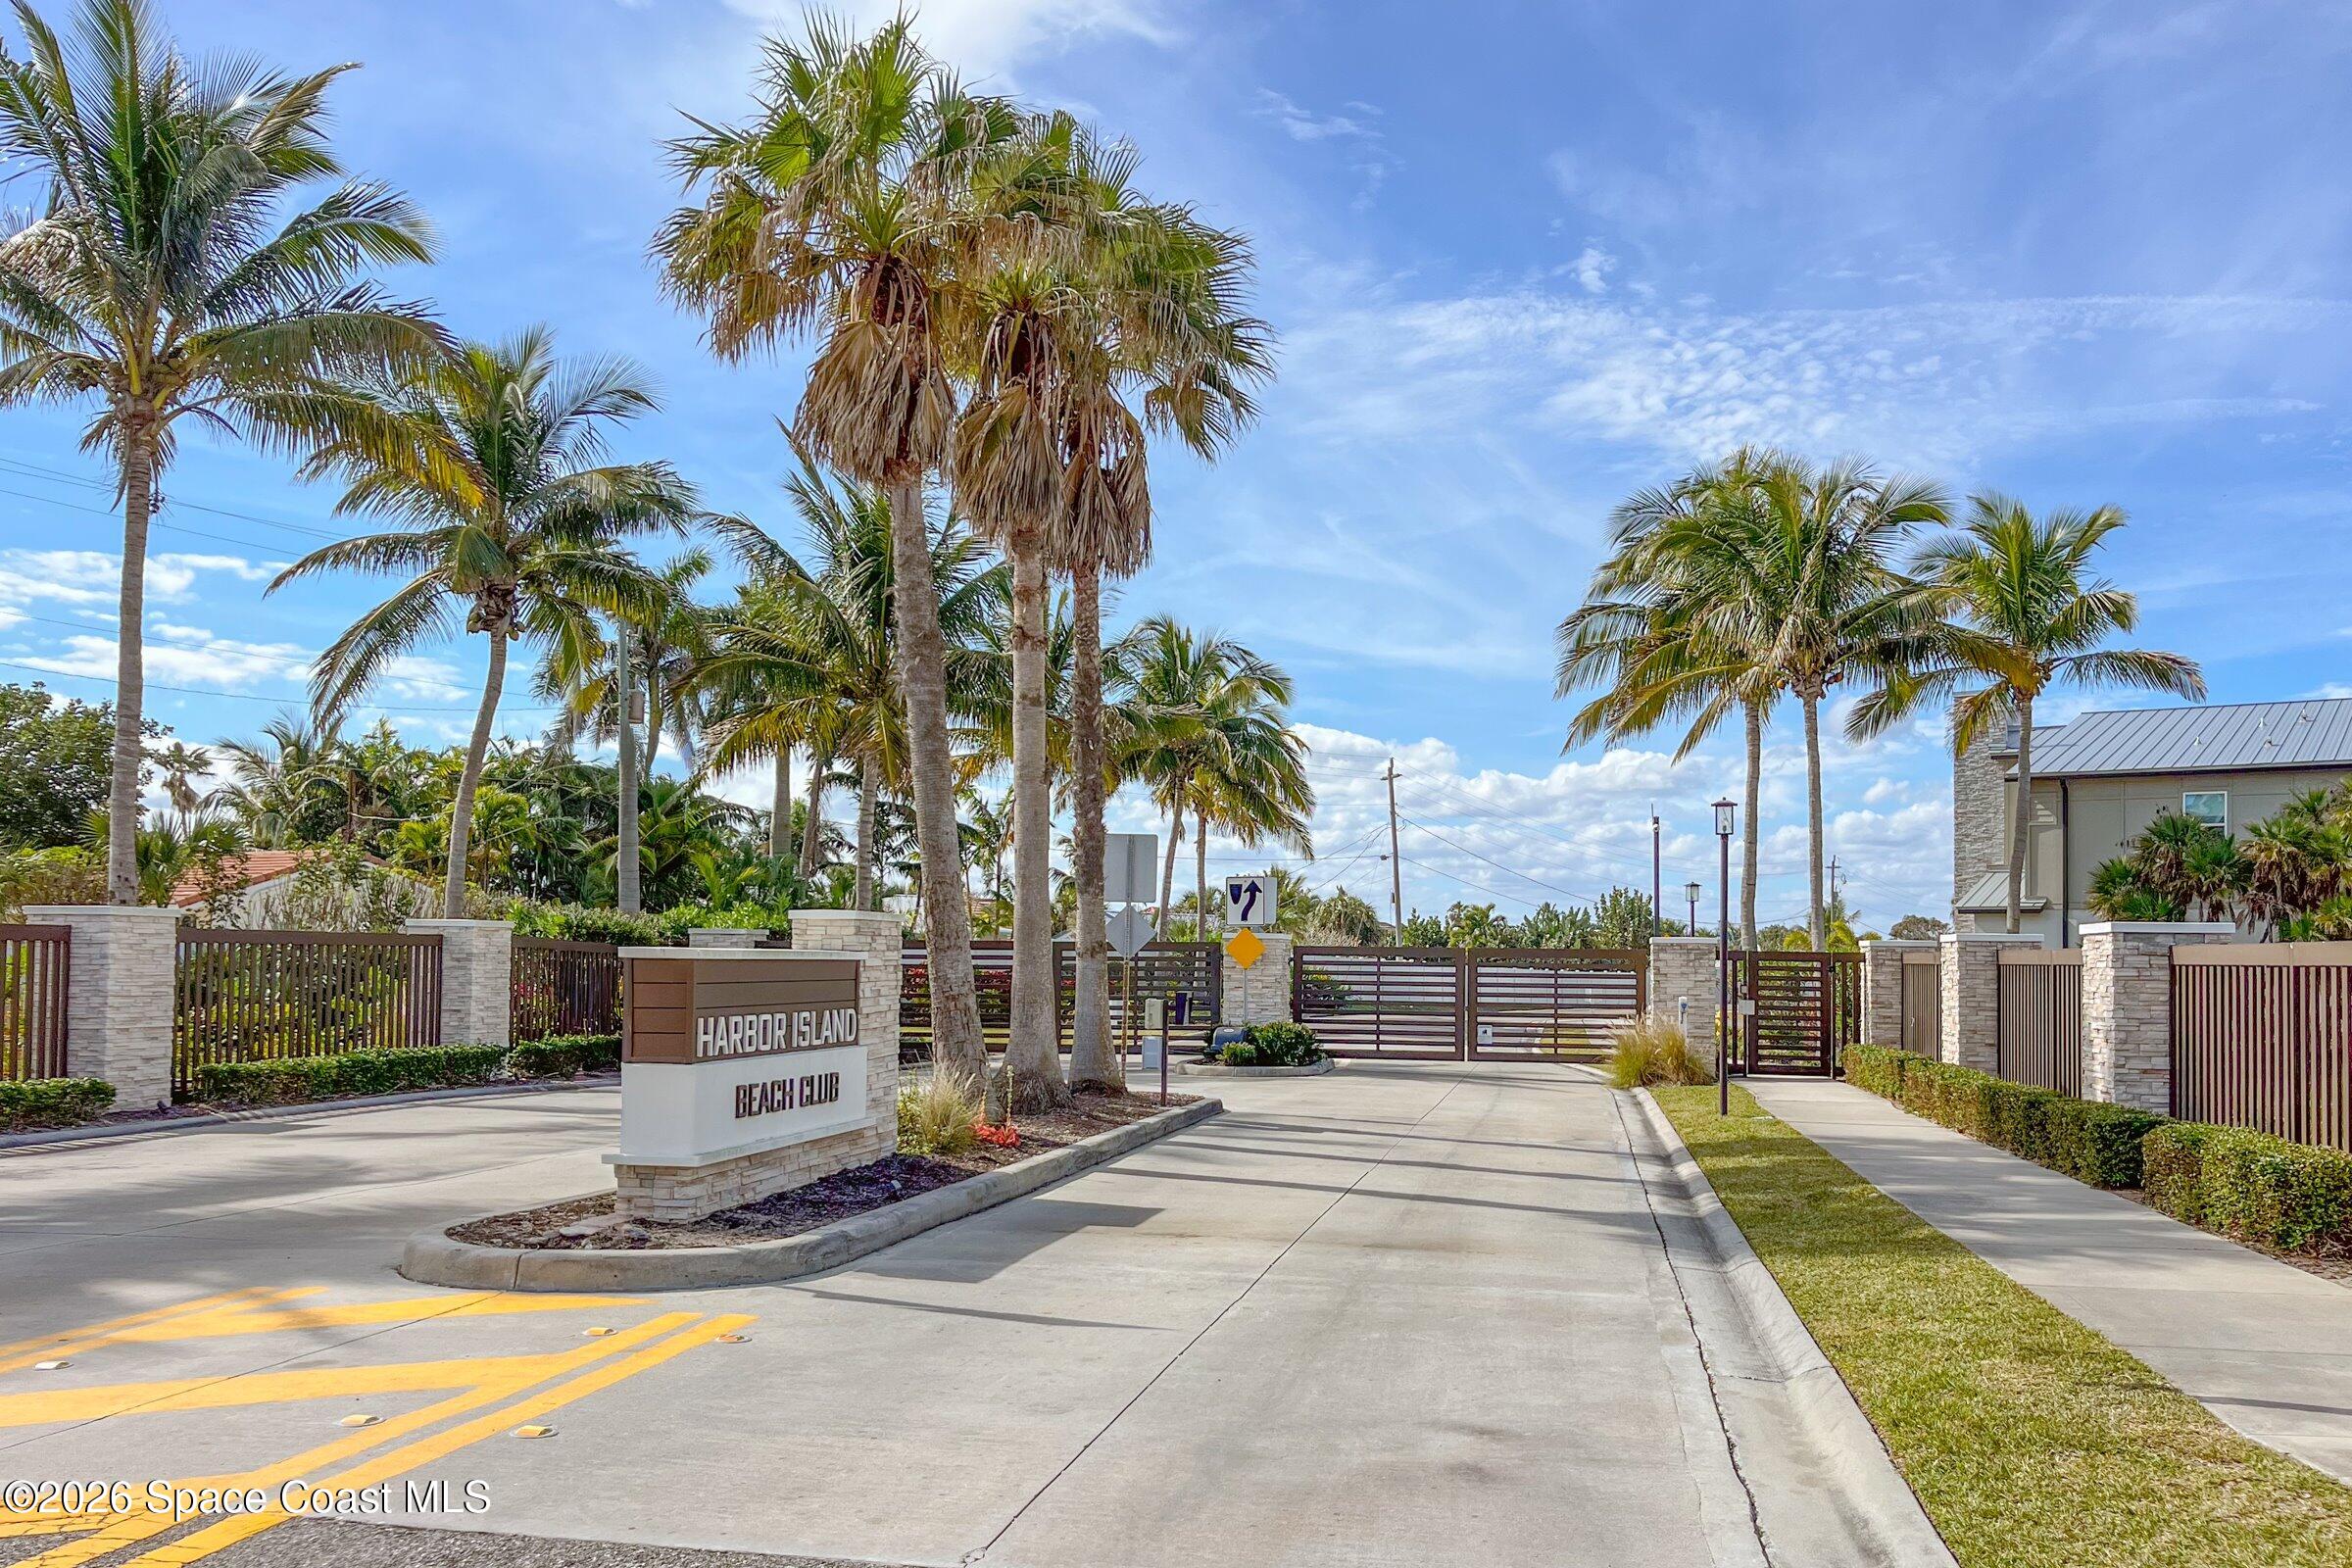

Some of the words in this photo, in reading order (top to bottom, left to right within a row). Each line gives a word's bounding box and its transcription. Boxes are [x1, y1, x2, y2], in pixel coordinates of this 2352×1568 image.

[696, 1012, 787, 1057] HARBOR
[791, 1007, 858, 1048] ISLAND
[735, 1078, 795, 1119] BEACH
[799, 1072, 840, 1107] CLUB
